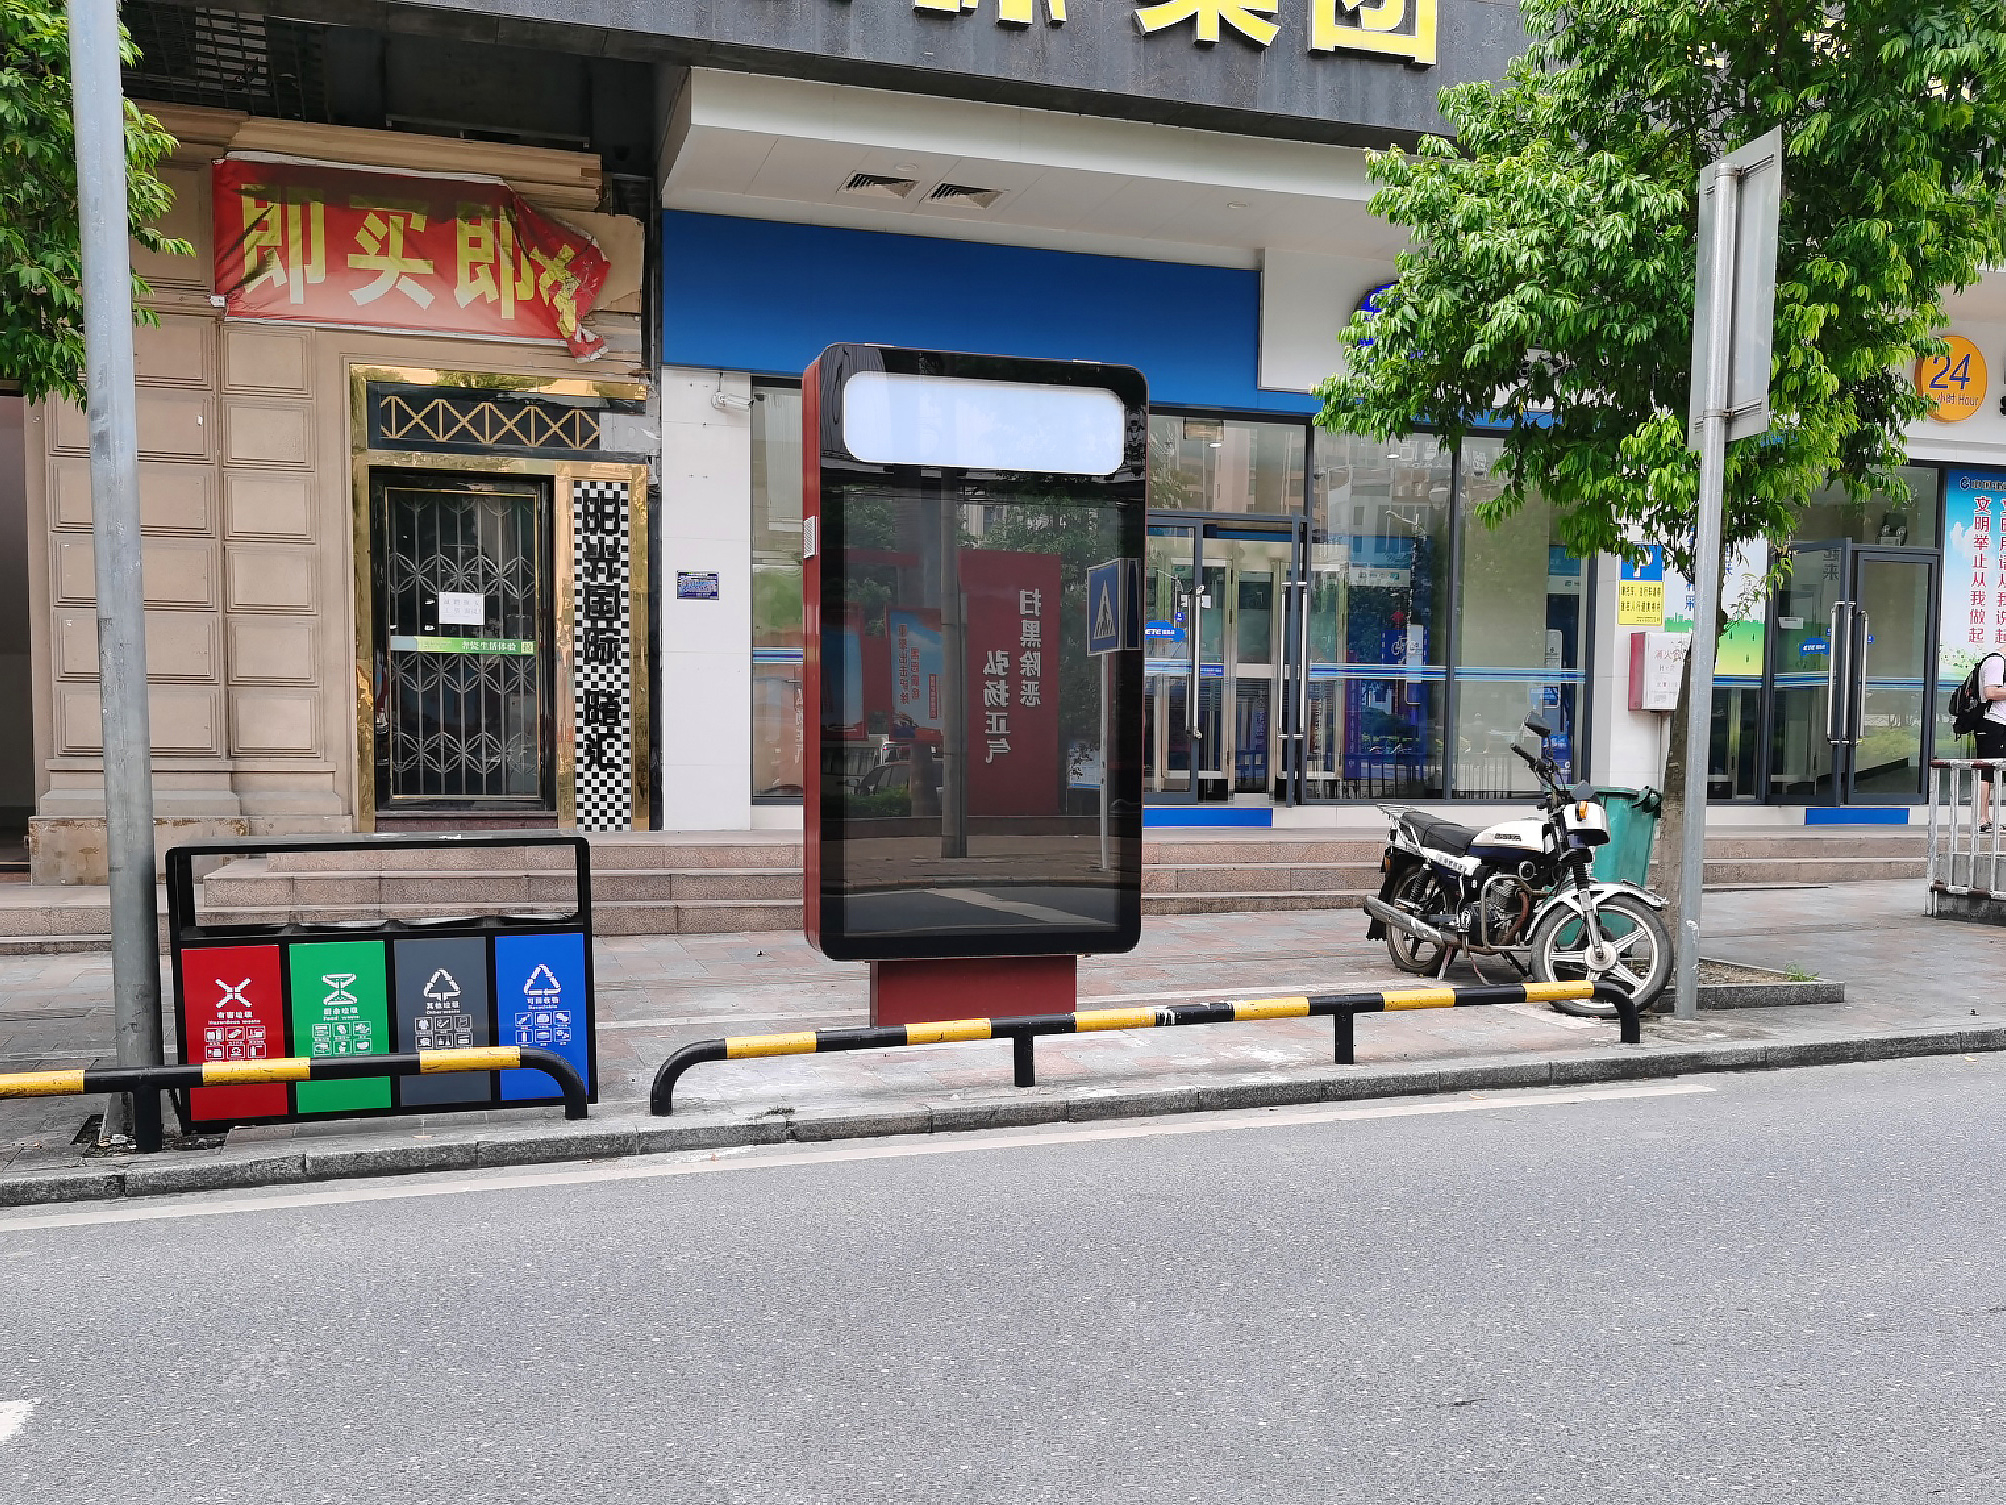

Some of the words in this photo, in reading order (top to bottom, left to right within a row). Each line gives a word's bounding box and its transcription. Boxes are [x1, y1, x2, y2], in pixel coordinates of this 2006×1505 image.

[1929, 353, 1971, 390] 24
[1958, 393, 1979, 406] Hour
[582, 490, 621, 664] 阳光国际
[1968, 495, 1992, 644] 文明举止从我做起
